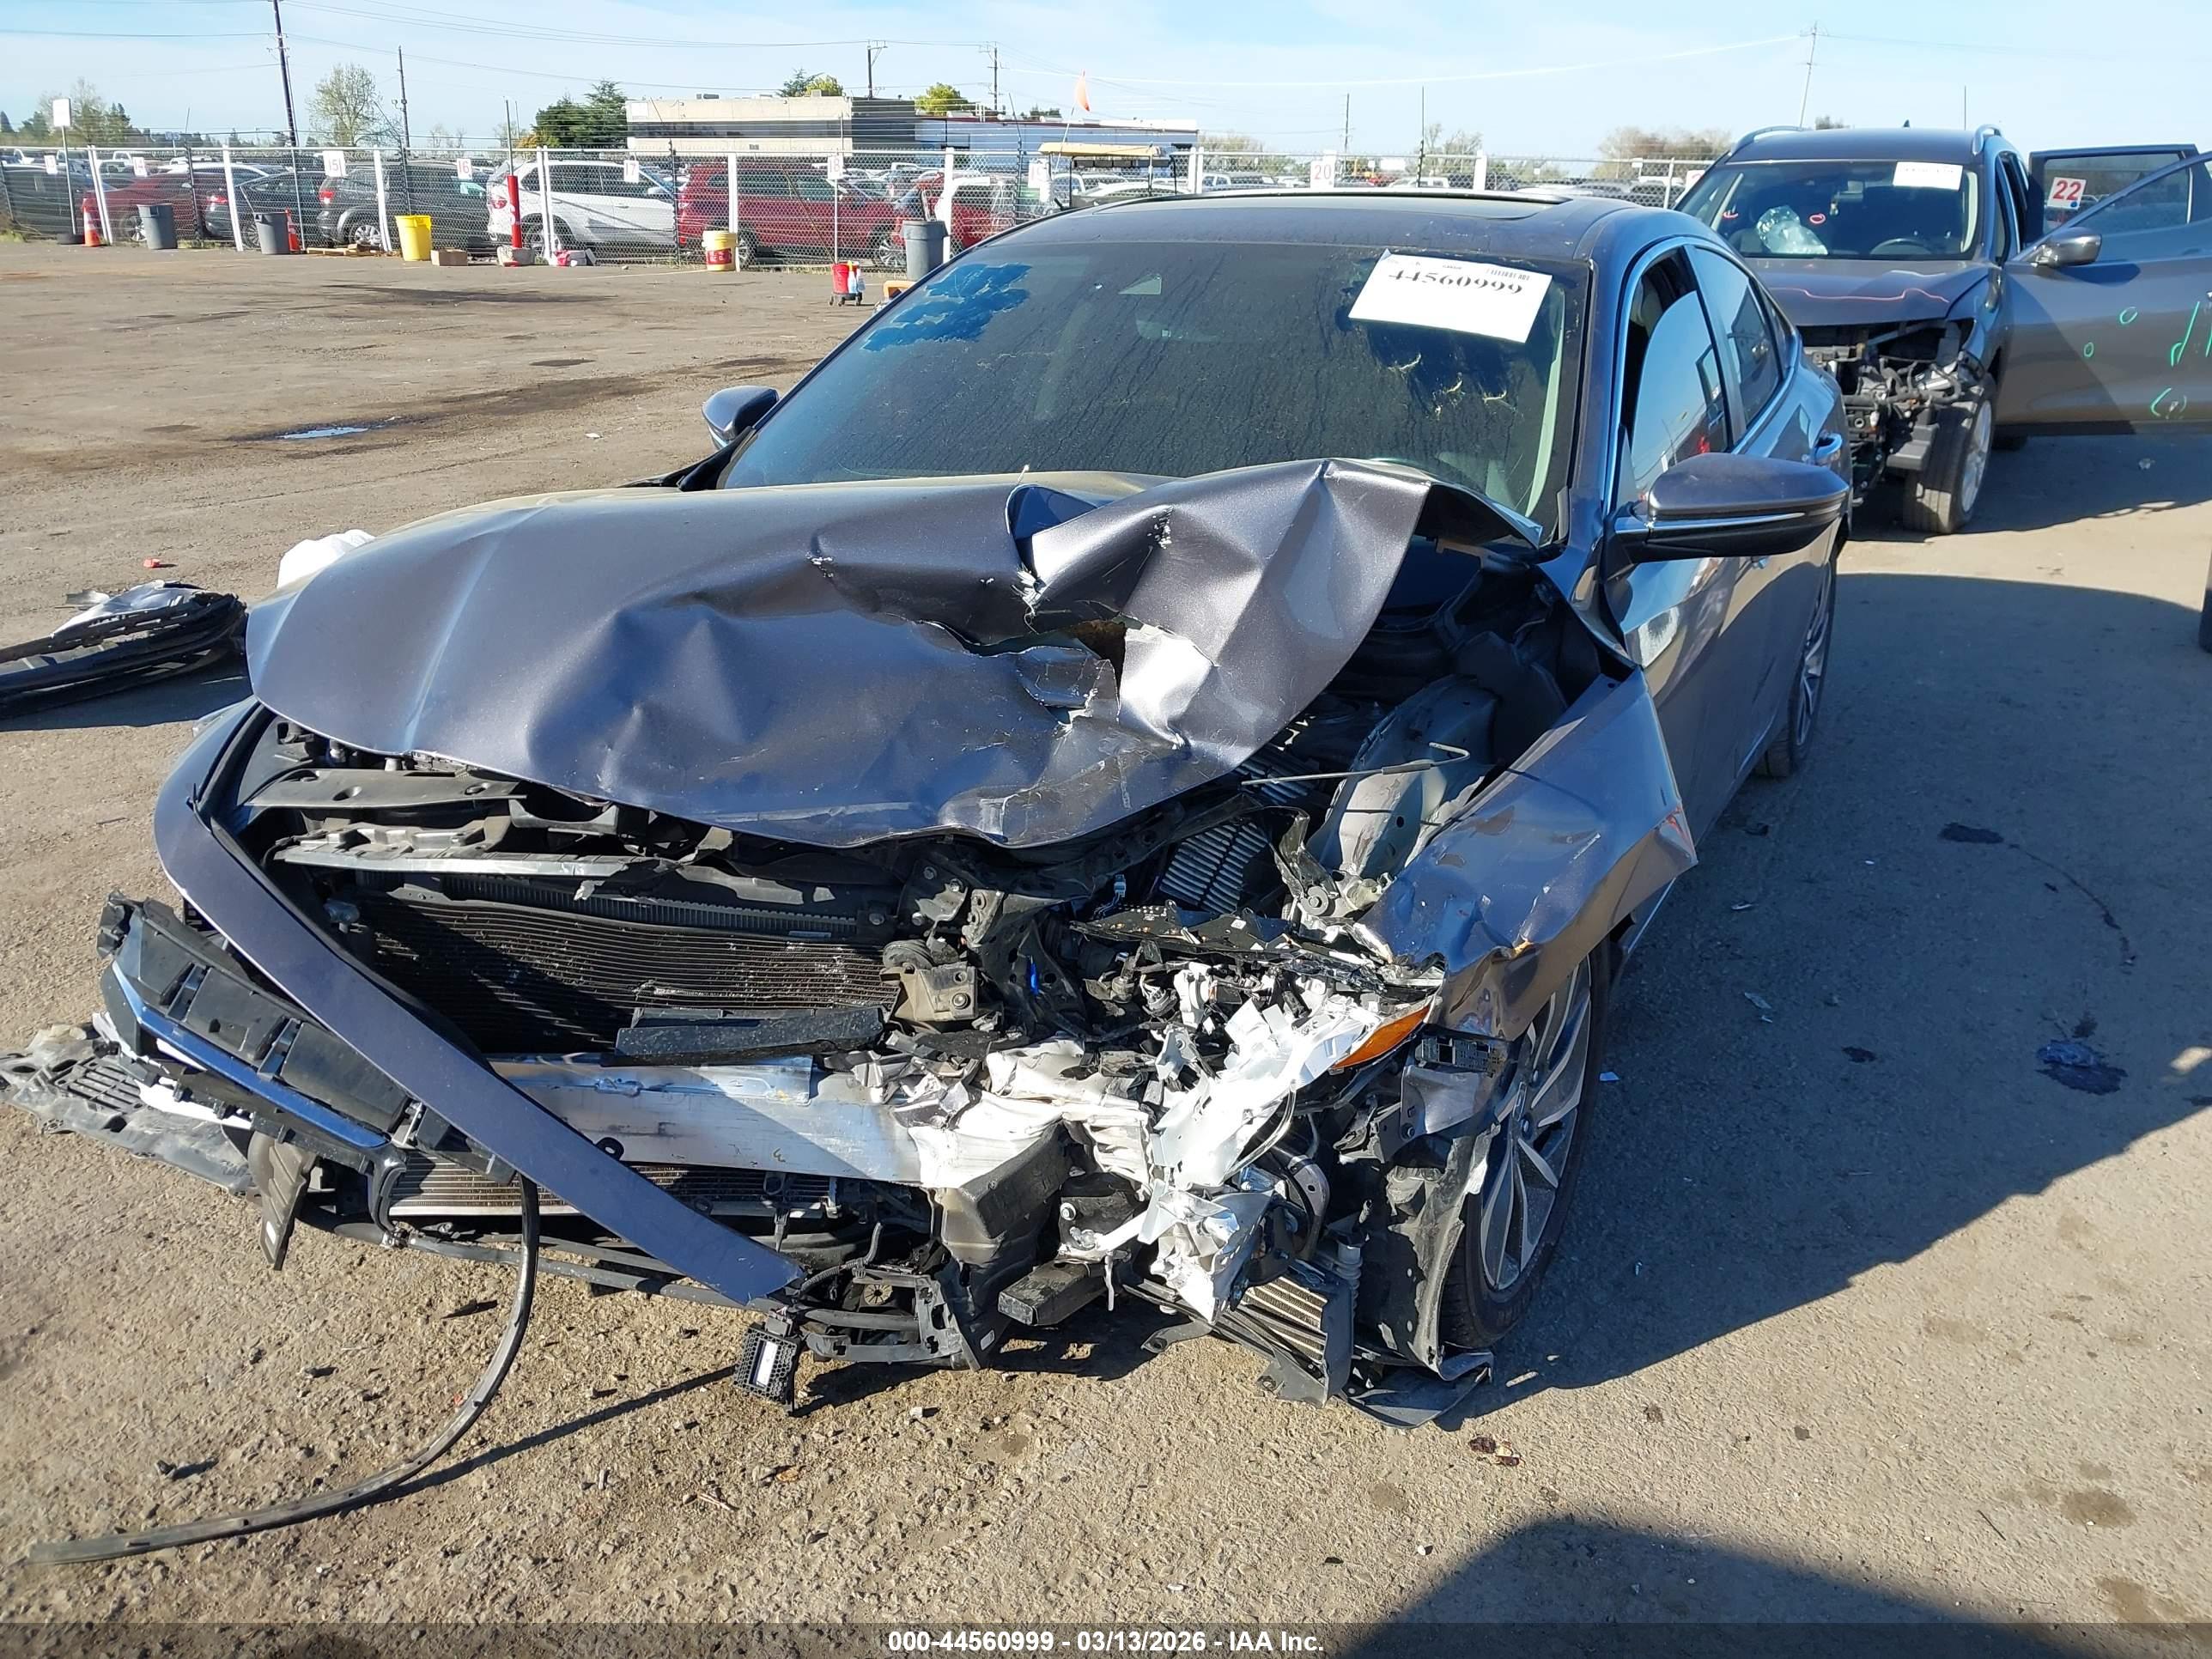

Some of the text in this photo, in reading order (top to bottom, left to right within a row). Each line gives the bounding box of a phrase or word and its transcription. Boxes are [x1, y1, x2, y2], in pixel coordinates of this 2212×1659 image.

[458, 161, 470, 173] 16
[626, 162, 635, 176] 17
[830, 158, 840, 173] 18
[1314, 164, 1332, 179] 20
[2053, 179, 2081, 200] 22
[1388, 270, 1523, 294] 44560999
